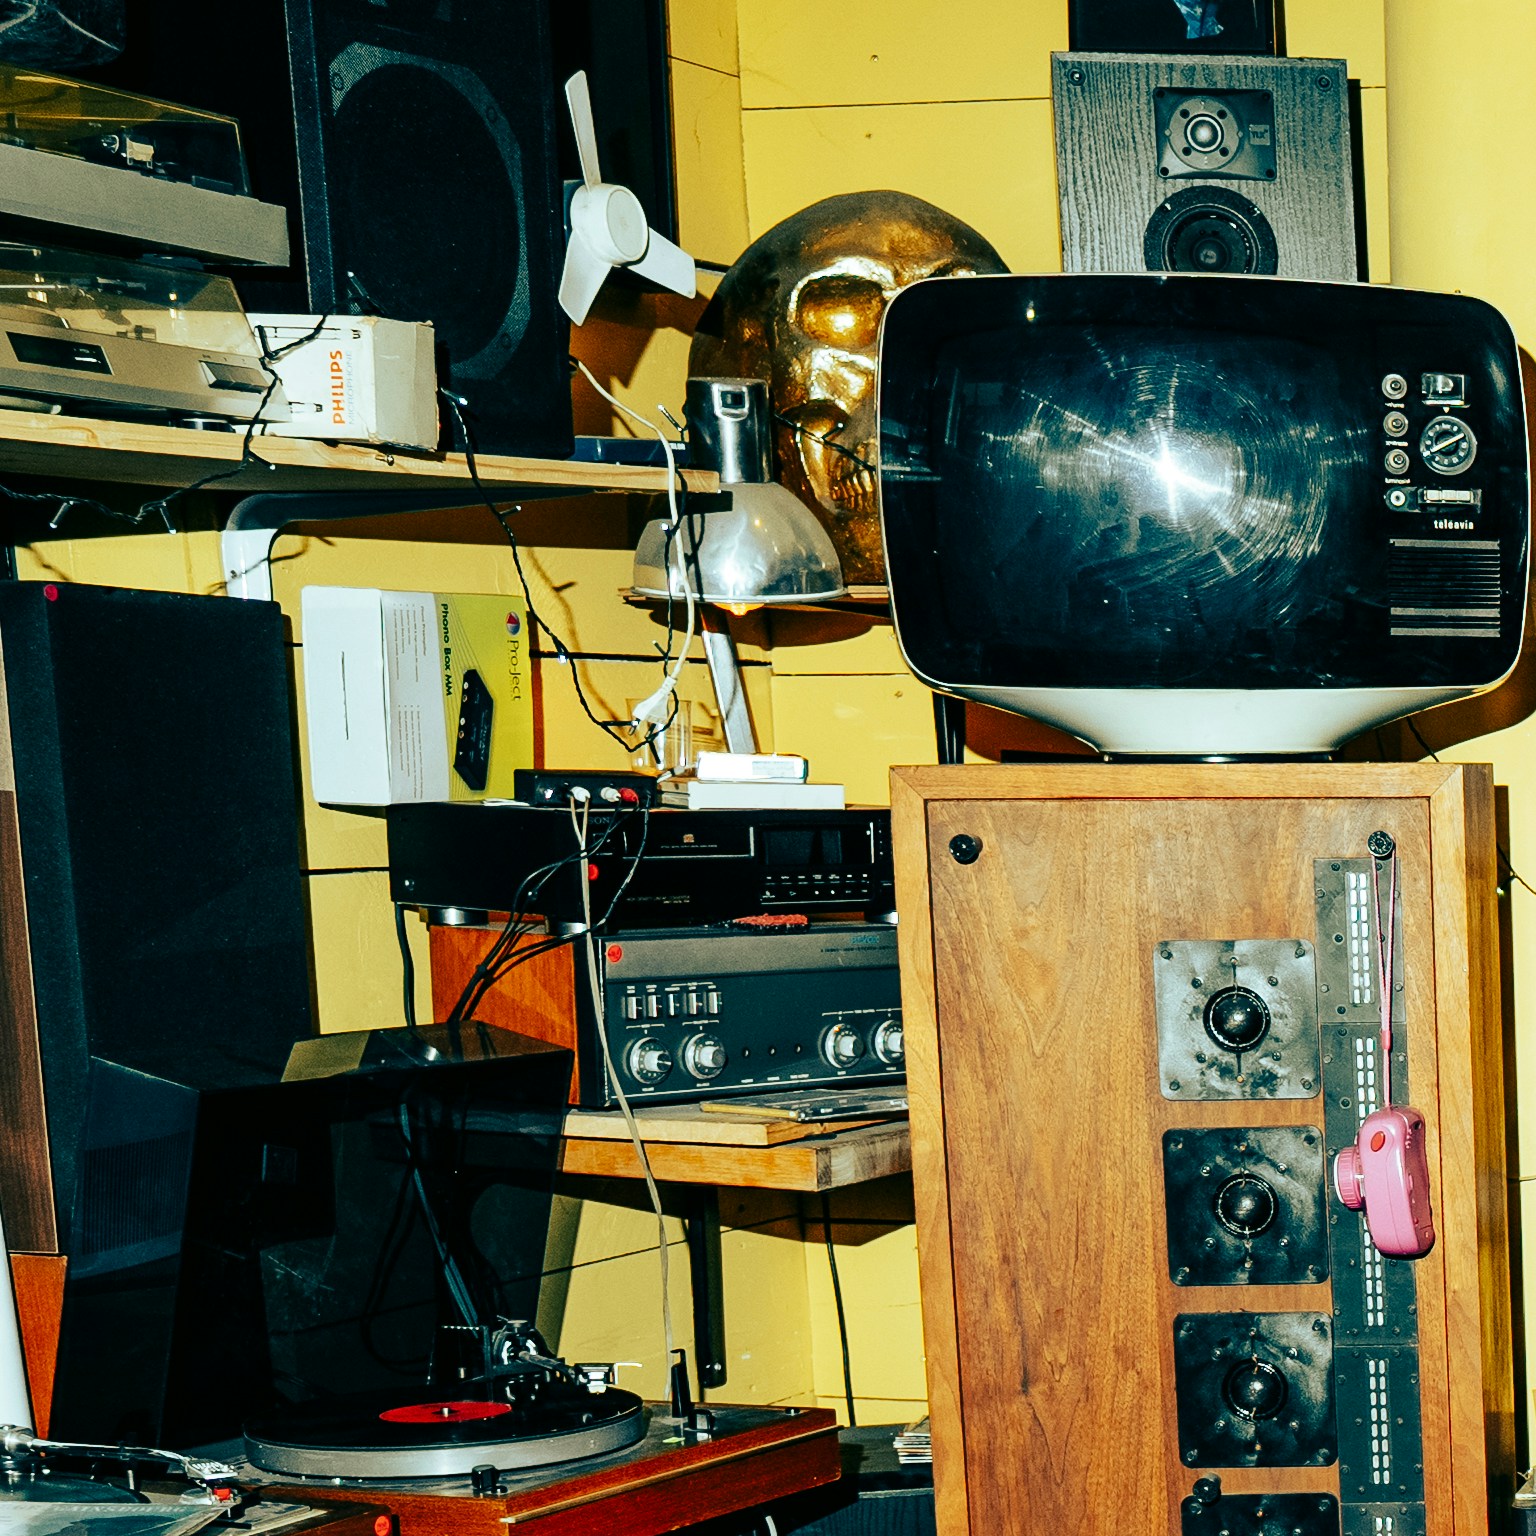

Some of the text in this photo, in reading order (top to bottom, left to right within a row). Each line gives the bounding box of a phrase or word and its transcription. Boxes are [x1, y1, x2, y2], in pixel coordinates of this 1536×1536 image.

[330, 350, 345, 425] PHILIPS
[346, 351, 355, 425] MICROPHONE
[441, 603, 450, 644] Phono
[445, 674, 452, 696] MM
[509, 640, 522, 700] Pro-Ject
